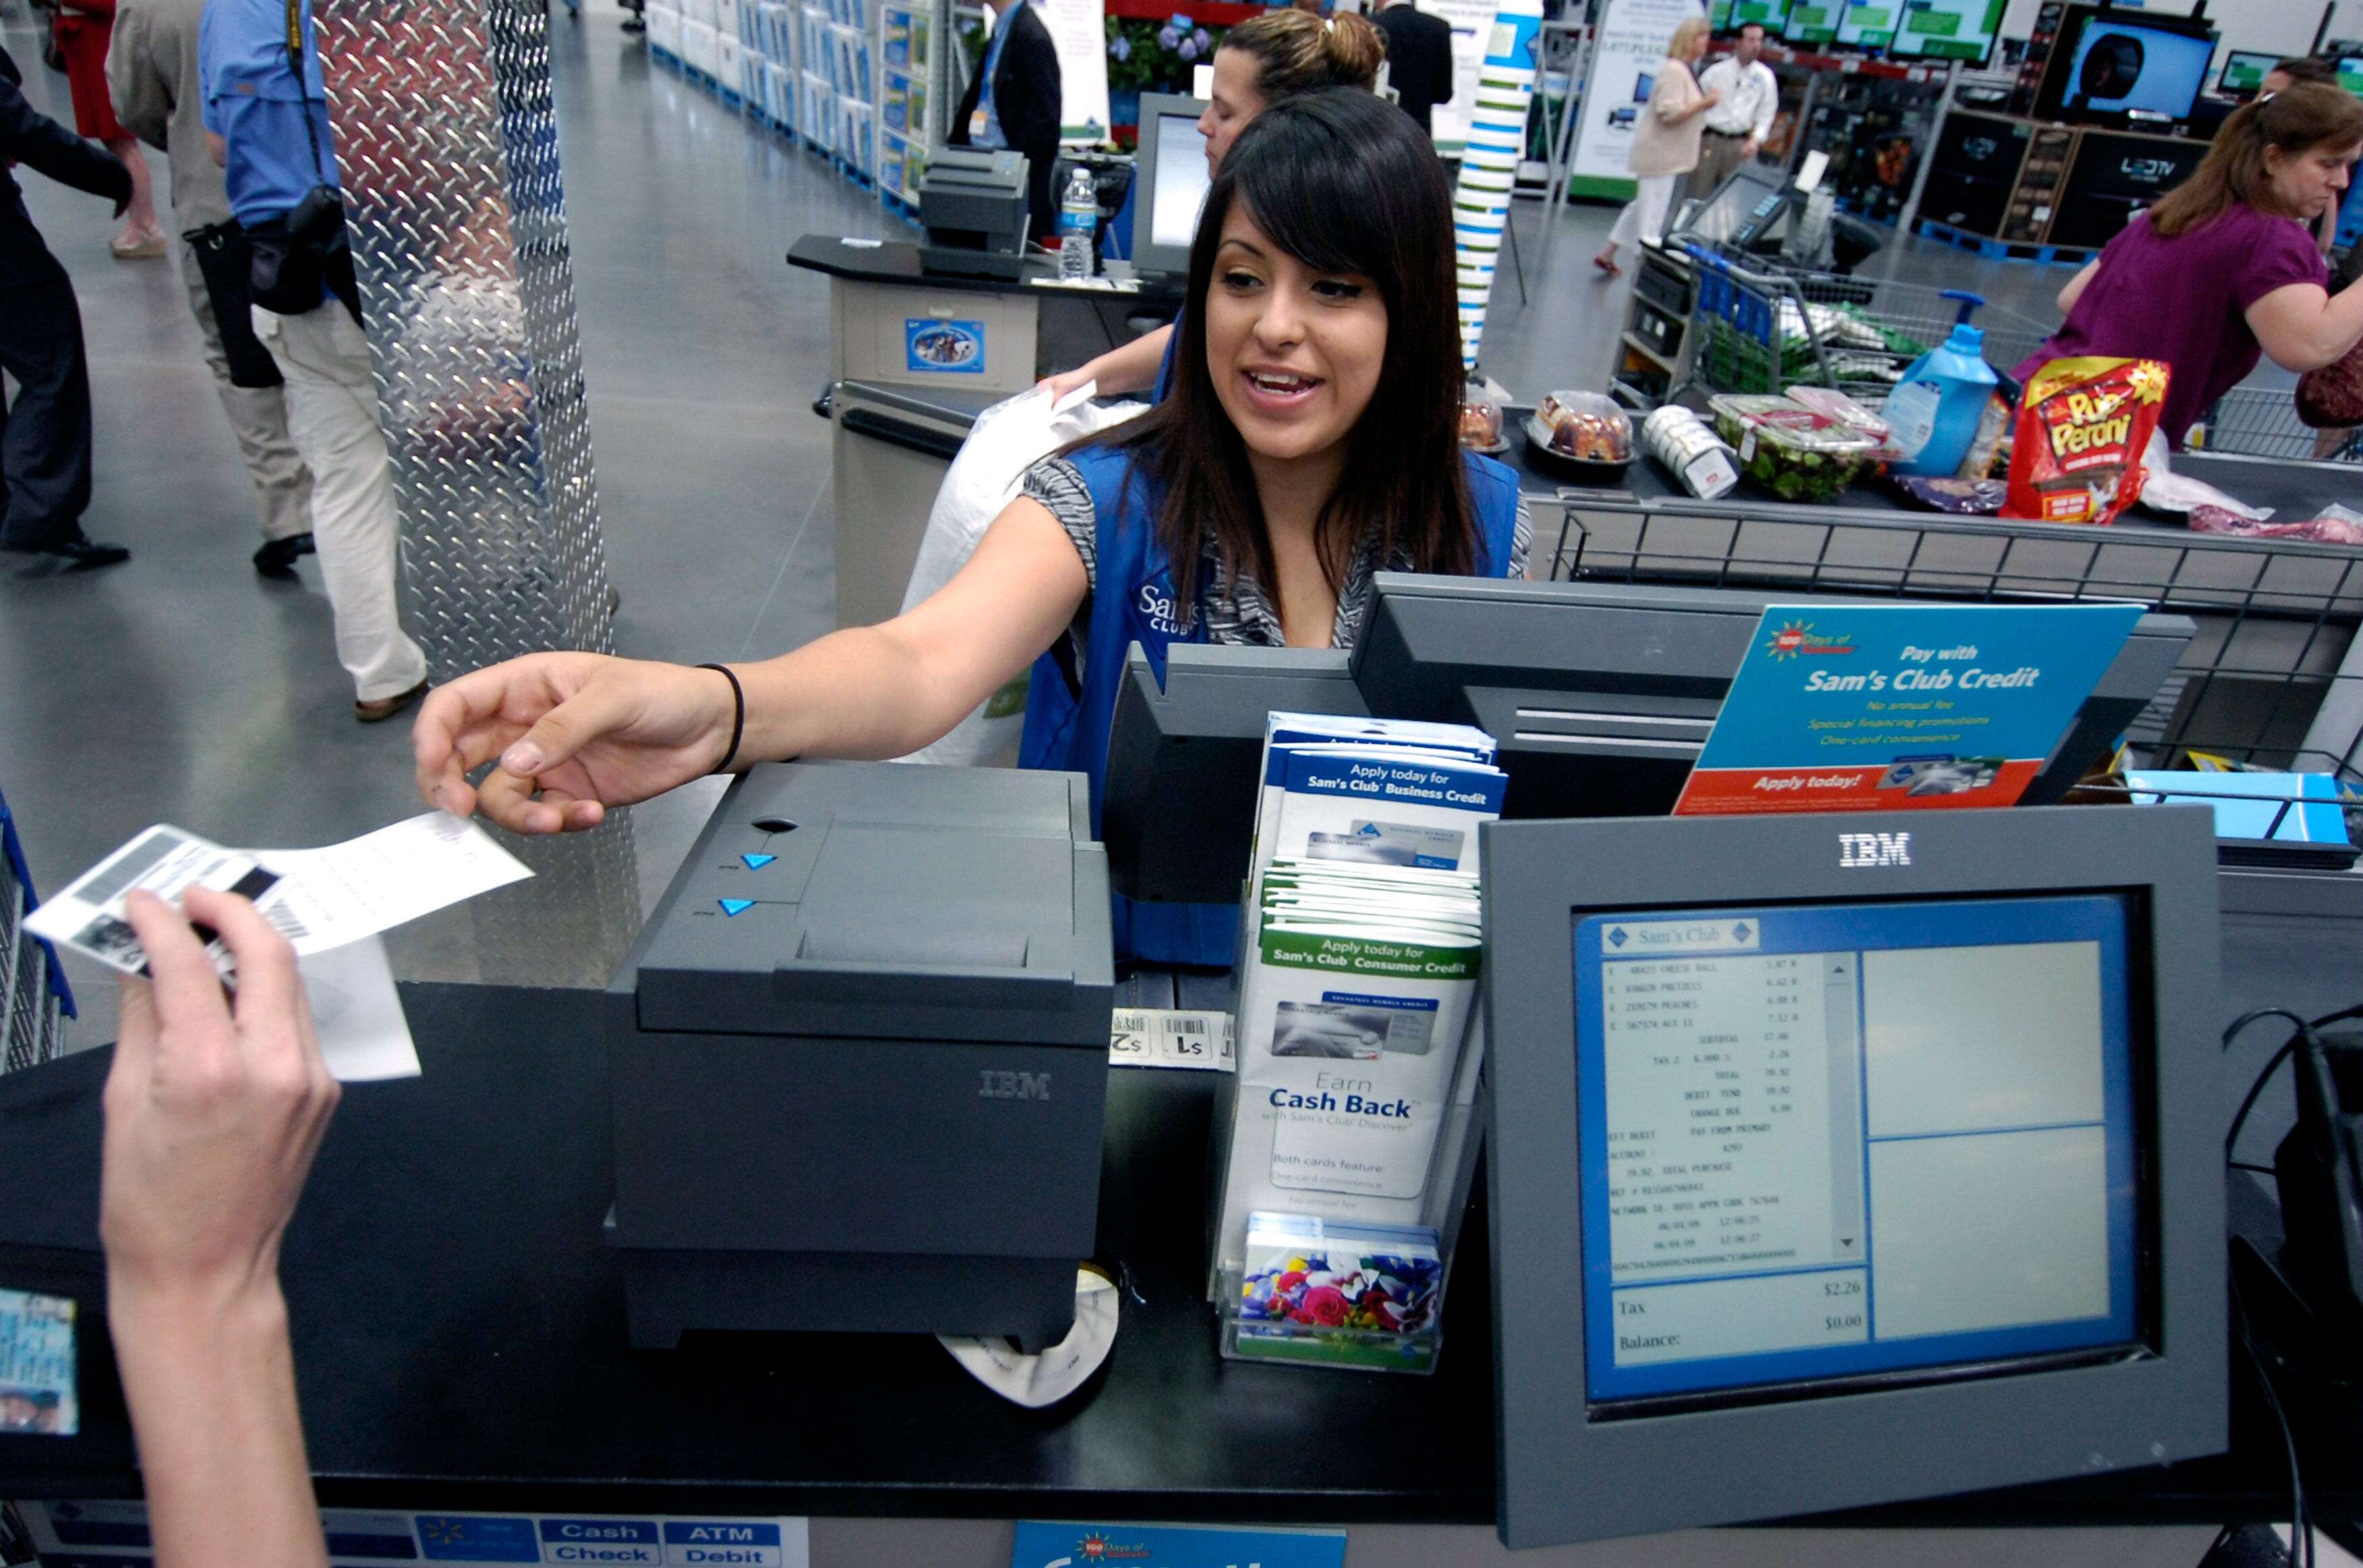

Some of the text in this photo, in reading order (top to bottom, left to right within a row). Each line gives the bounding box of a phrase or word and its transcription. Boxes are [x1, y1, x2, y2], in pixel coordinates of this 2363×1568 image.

[2051, 414, 2131, 458] Peroni
[1150, 618, 1188, 635] CLUB
[1900, 645, 1978, 663] Pay with
[1805, 667, 2040, 691] Sam's Club Credit
[1867, 701, 1886, 711] No
[1808, 715, 1990, 730] Special financing promotions
[1821, 734, 1881, 745] One-card
[1351, 764, 1449, 784] Apply today for
[1308, 776, 1487, 805] Sam's Club Business Credit
[1754, 774, 1863, 792] Apply today!
[1838, 833, 1912, 867] IBM
[1639, 927, 1720, 943] Sam's Club
[1322, 939, 1424, 958] Apply today for
[1273, 950, 1466, 973] Sam's Club Consumer Credit
[1316, 1071, 1372, 1093] Earn
[1715, 1070, 1740, 1080] TOTAL
[979, 1070, 1051, 1100] IBM
[1269, 1088, 1336, 1111] Cash
[1684, 1090, 1710, 1100] DEBIT
[1291, 1112, 1323, 1124] Sam's
[1690, 1108, 1720, 1117] CHANGE
[1726, 1107, 1741, 1116] DUE
[1629, 1130, 1655, 1140] DEBIT
[1711, 1125, 1732, 1135] FROM
[1736, 1123, 1772, 1133] PRIMARY
[1610, 1149, 1645, 1159] ACCOUNT
[1273, 1153, 1385, 1173] Both cards feature:
[1662, 1165, 1687, 1175] TOTAL
[1691, 1162, 1733, 1173] PURCHASE
[1272, 1171, 1383, 1189] One-card convenience
[1619, 1281, 1861, 1316] Tax $2.26
[1620, 1314, 1862, 1349] Balance: $0.00
[561, 1524, 638, 1539] Cash
[689, 1528, 753, 1542] ATM
[556, 1546, 649, 1563] Check
[685, 1548, 763, 1564] Debit
